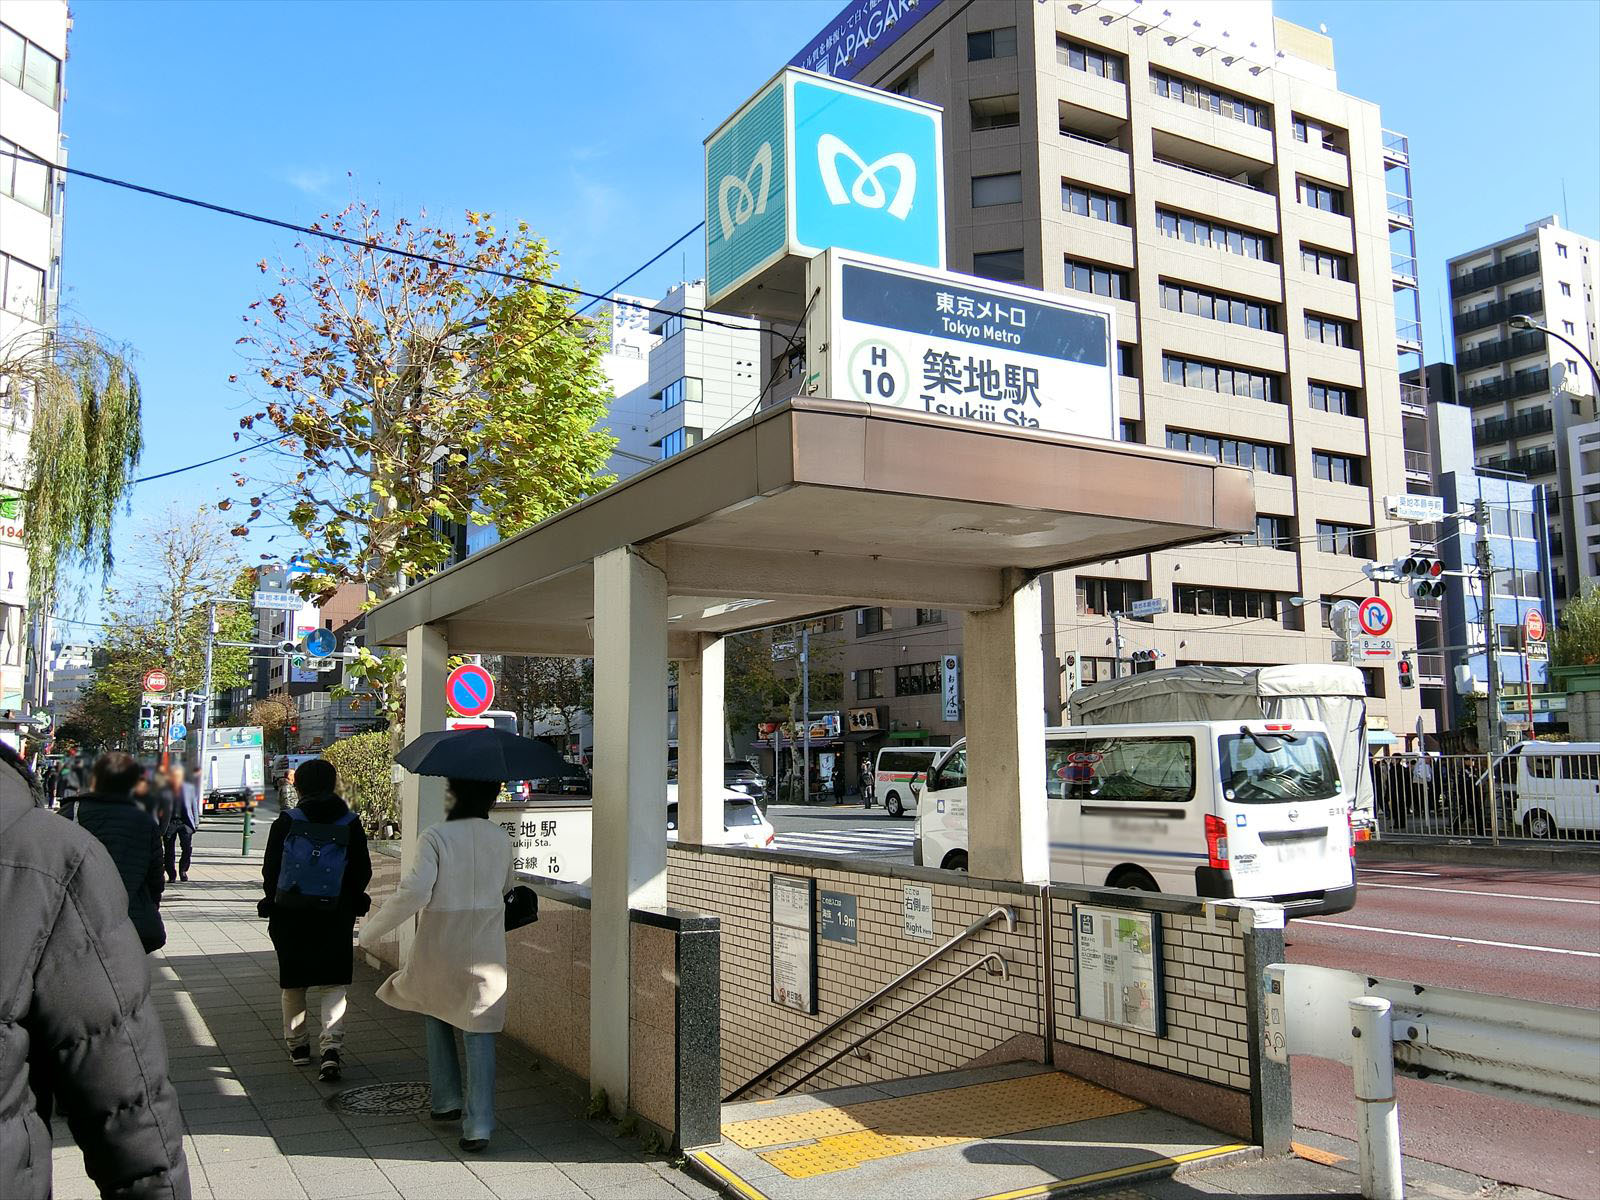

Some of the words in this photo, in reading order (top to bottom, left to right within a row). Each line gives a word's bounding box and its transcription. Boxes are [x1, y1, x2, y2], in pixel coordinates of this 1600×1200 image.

[936, 292, 1026, 328] 東京メトロ
[942, 317, 980, 339] Tokyo
[983, 325, 1021, 345] Metro
[872, 346, 887, 367] H
[863, 369, 895, 398] 10
[923, 348, 1042, 408] 築地駅
[500, 821, 557, 838] 築地駅
[512, 839, 532, 849] ukiji
[534, 839, 551, 847] Sta.
[547, 865, 560, 873] 10
[837, 911, 856, 928] 1.9m
[905, 921, 922, 934] Right
